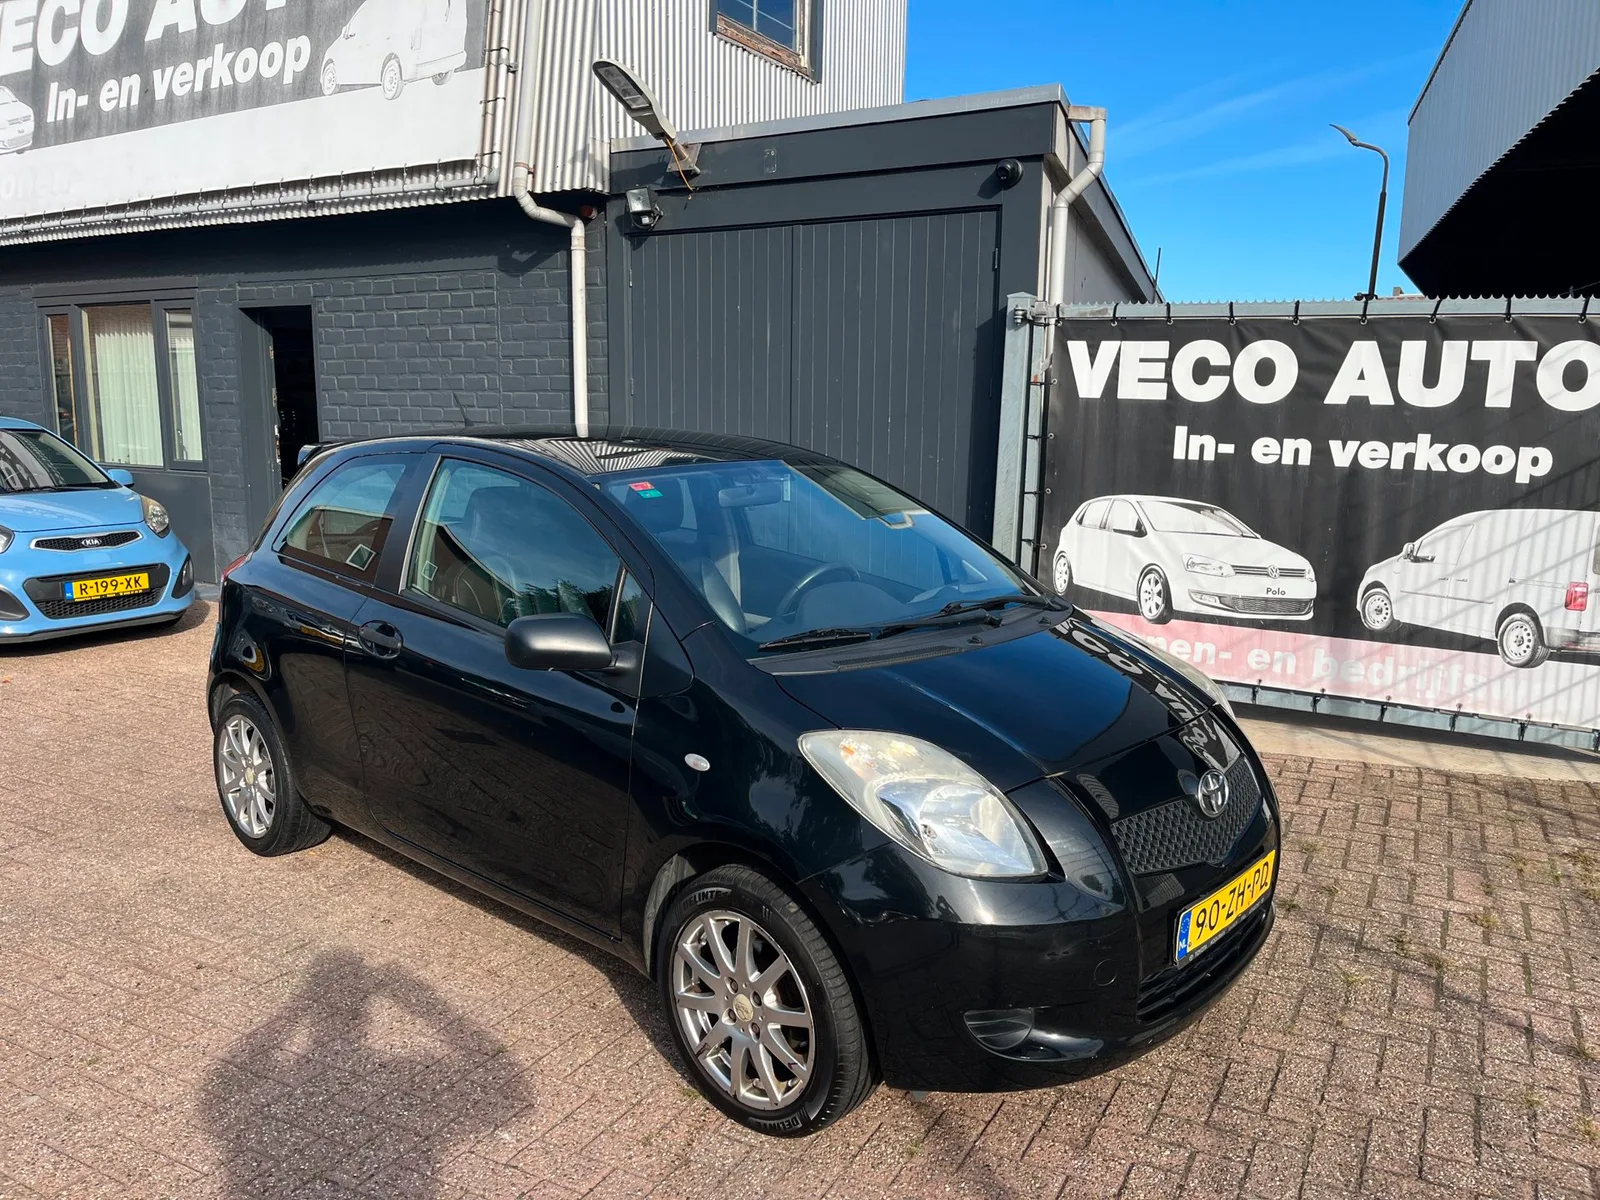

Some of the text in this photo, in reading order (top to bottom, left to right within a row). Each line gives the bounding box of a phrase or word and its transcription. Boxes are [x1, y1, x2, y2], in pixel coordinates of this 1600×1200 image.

[46, 35, 311, 124] In- en verkoop
[1066, 339, 1600, 412] VECO AUTO
[1172, 425, 1554, 484] In- en verkoop
[79, 576, 142, 596] R-199-XK
[1266, 587, 1286, 596] Polo
[1247, 648, 1297, 675] en
[1178, 939, 1187, 951] NL
